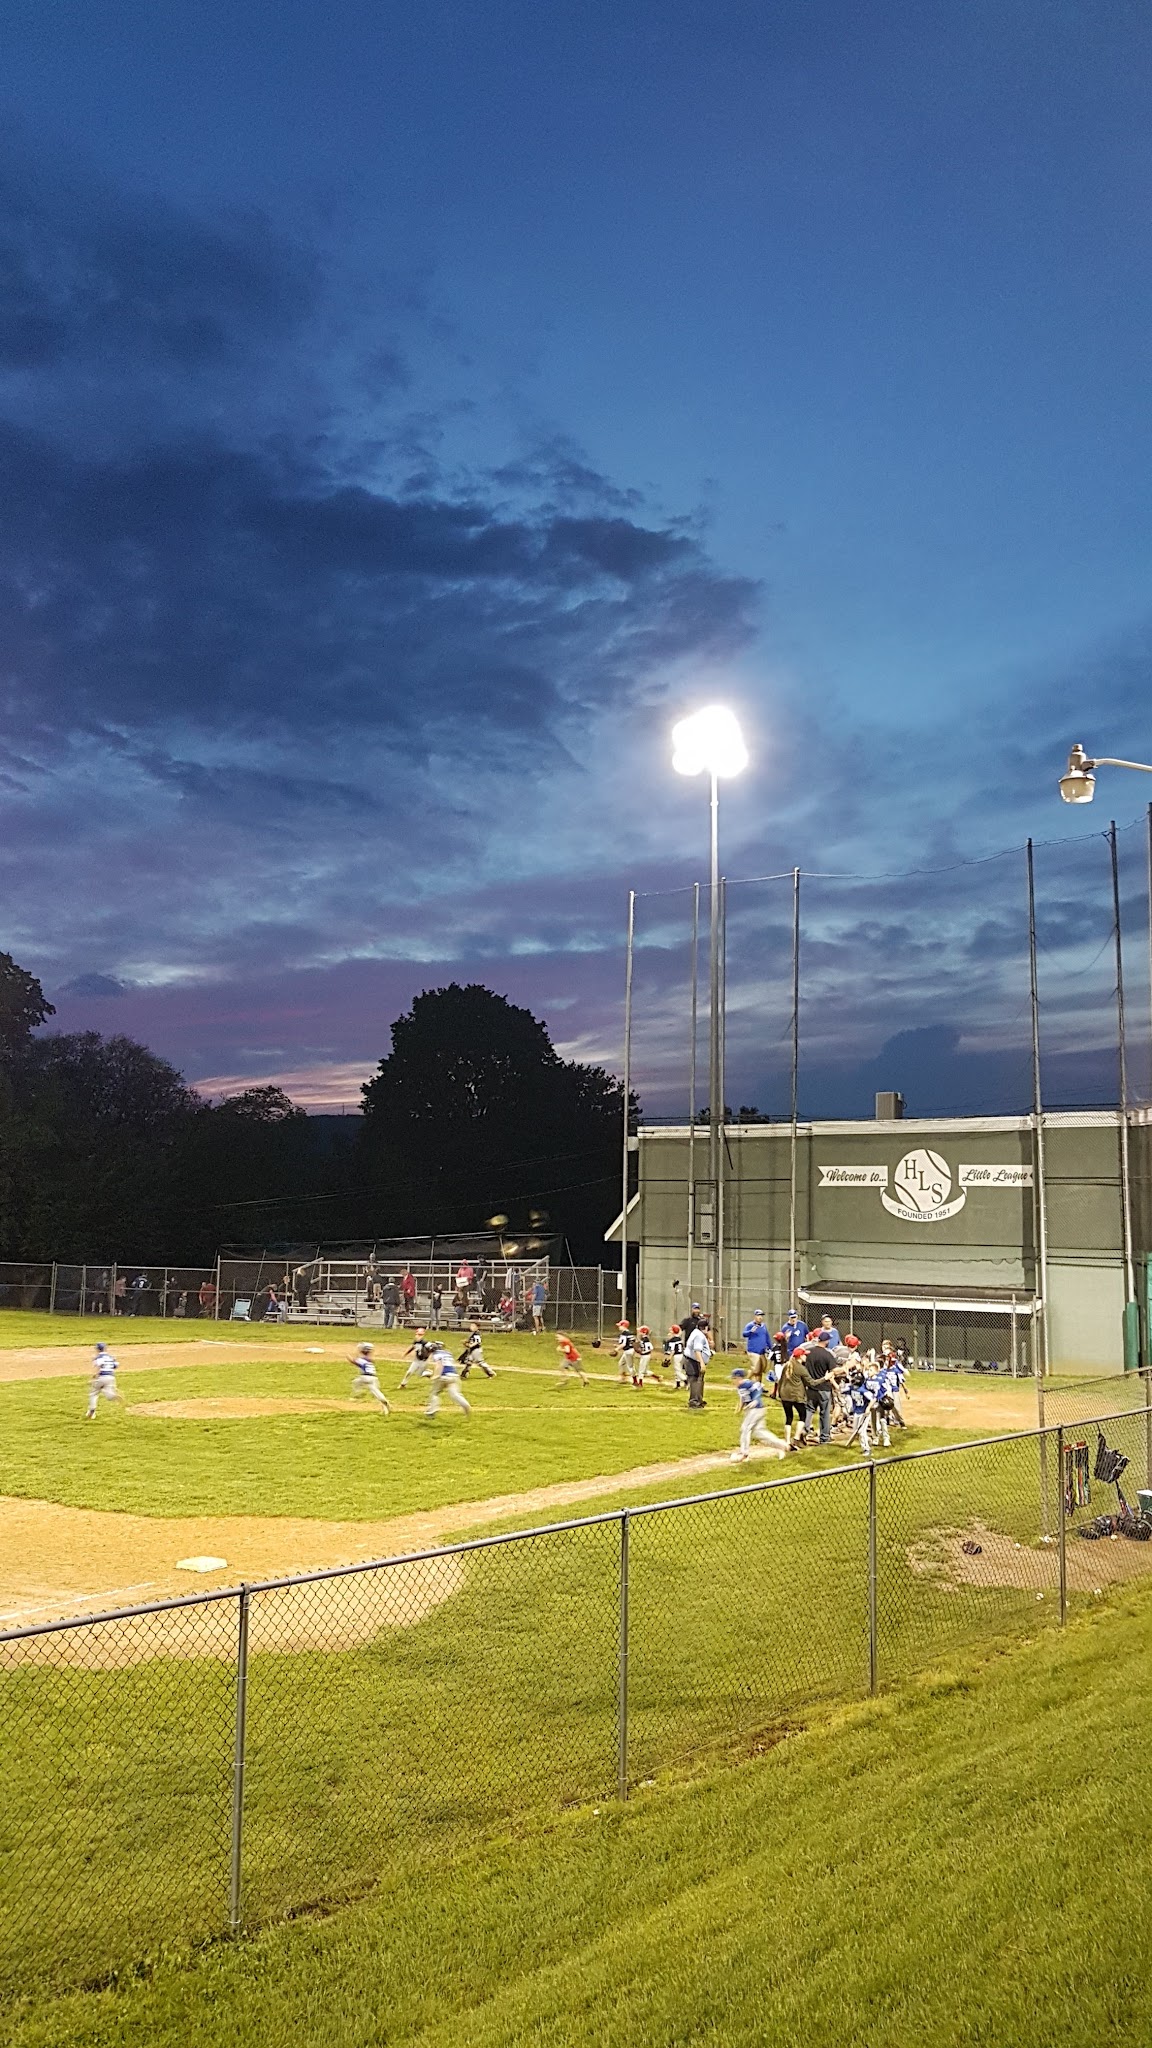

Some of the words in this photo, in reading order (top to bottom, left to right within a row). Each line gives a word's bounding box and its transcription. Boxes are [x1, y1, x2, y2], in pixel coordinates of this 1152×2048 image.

[826, 1168, 868, 1182] Welcome
[962, 1168, 991, 1182] Little
[992, 1169, 1028, 1184] League
[897, 1208, 933, 1220] FOUNDED
[935, 1208, 951, 1218] 1951
